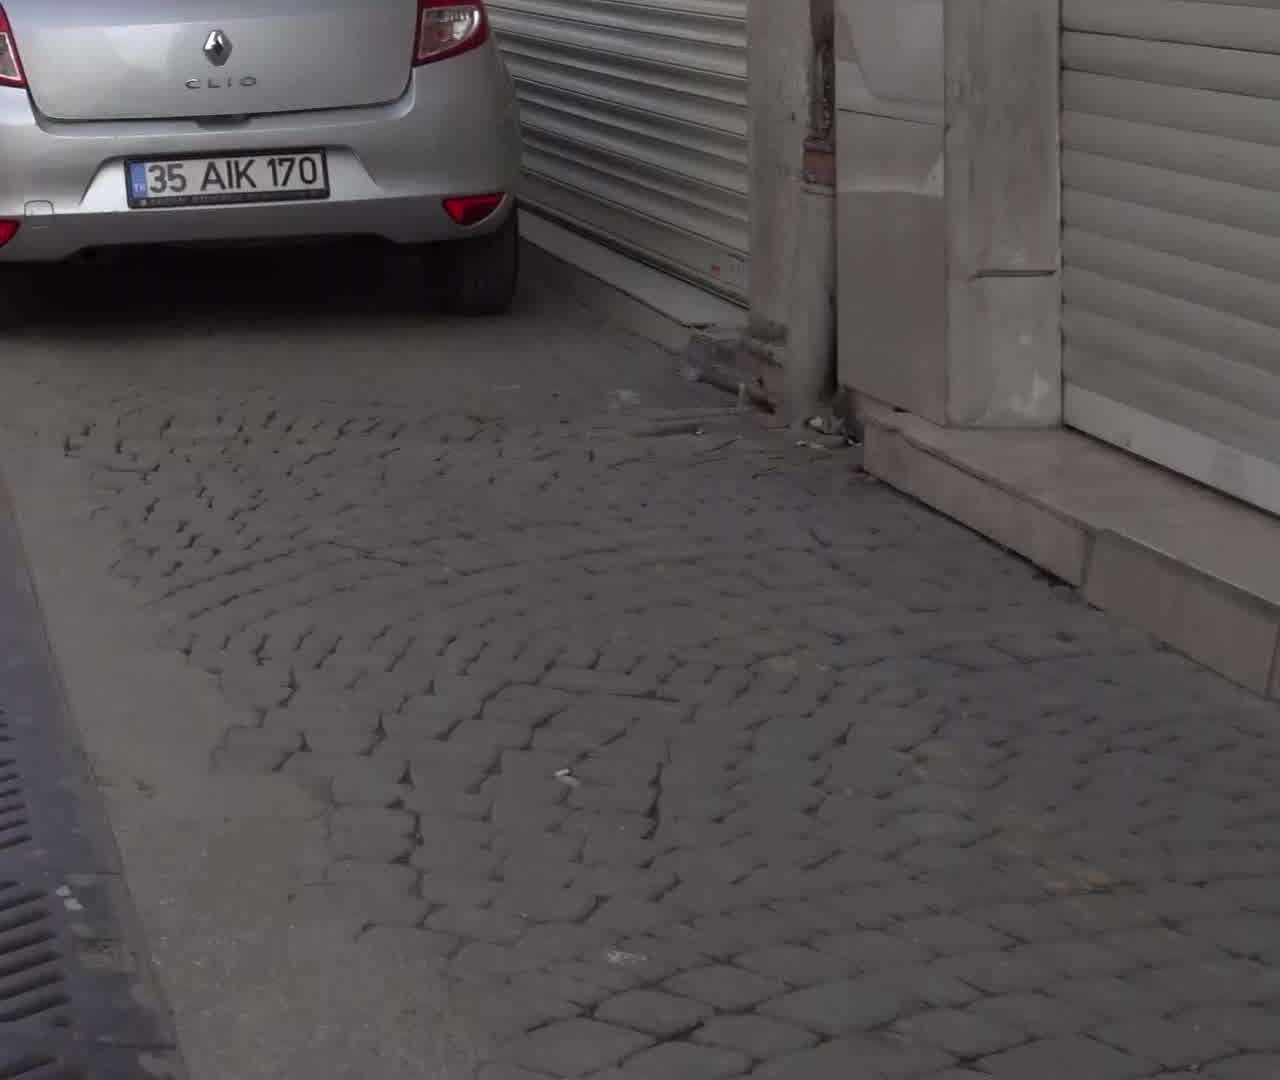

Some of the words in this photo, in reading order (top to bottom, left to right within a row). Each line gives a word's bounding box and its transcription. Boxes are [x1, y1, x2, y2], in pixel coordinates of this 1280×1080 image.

[184, 76, 257, 89] CLIO
[148, 163, 187, 193] 35
[200, 159, 257, 192] AIK
[266, 156, 318, 187] 170
